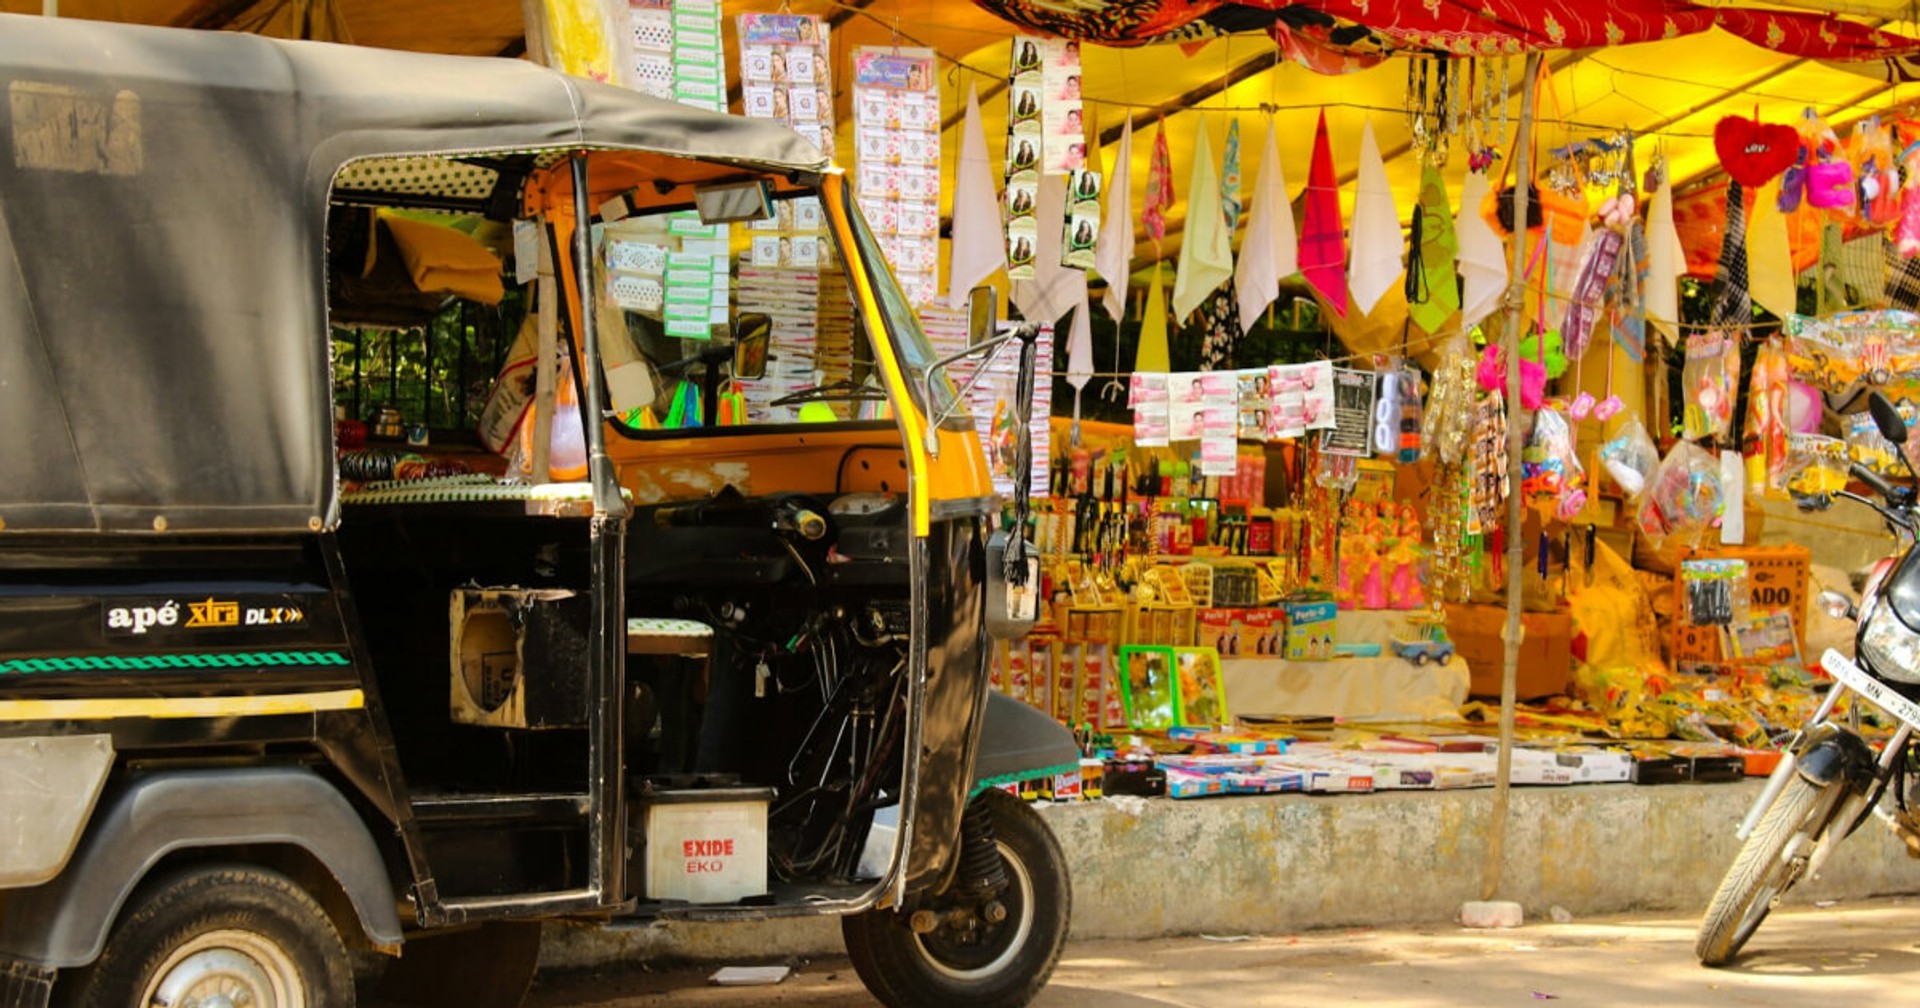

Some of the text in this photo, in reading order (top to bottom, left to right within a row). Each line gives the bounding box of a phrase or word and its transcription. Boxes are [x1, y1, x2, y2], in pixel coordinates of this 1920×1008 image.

[1751, 587, 1791, 605] ADO
[108, 596, 283, 633] apé xtra DLX
[1864, 683, 1882, 700] MN
[682, 838, 734, 857] EXIDE
[686, 860, 723, 873] EKO
